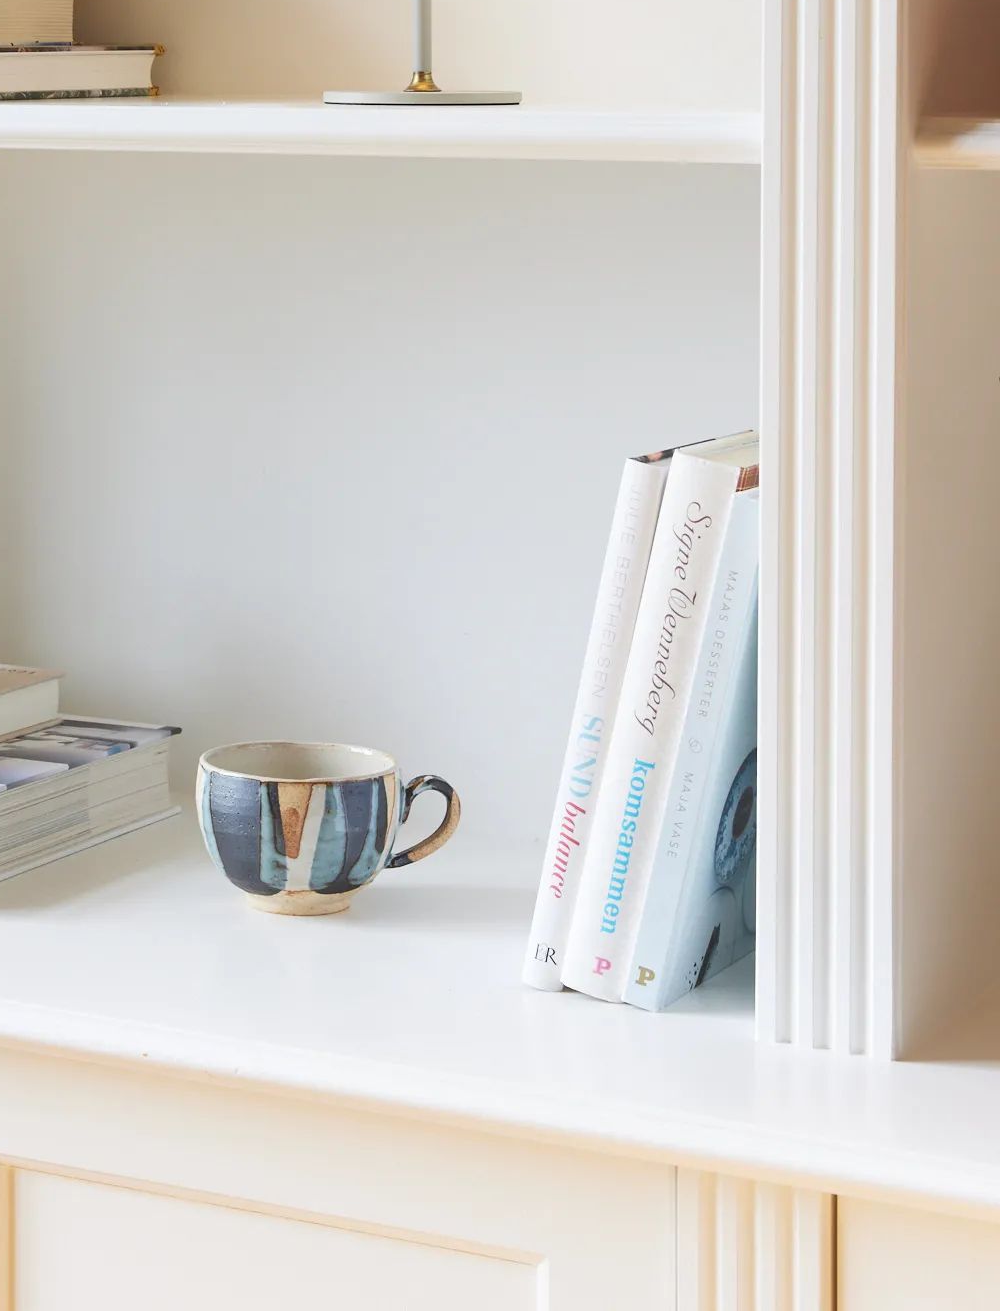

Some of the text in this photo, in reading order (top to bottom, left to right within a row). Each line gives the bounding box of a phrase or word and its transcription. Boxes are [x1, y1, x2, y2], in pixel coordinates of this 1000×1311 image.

[591, 555, 631, 699] BERTHELSEN
[634, 501, 713, 737] Signe Wenneberg
[696, 570, 739, 718] MAJAS DESSERTER
[549, 713, 604, 899] SUND balance
[599, 757, 656, 935] komsammen
[666, 771, 694, 858] MAJA VASE
[591, 956, 612, 976] P
[634, 965, 656, 987] P
